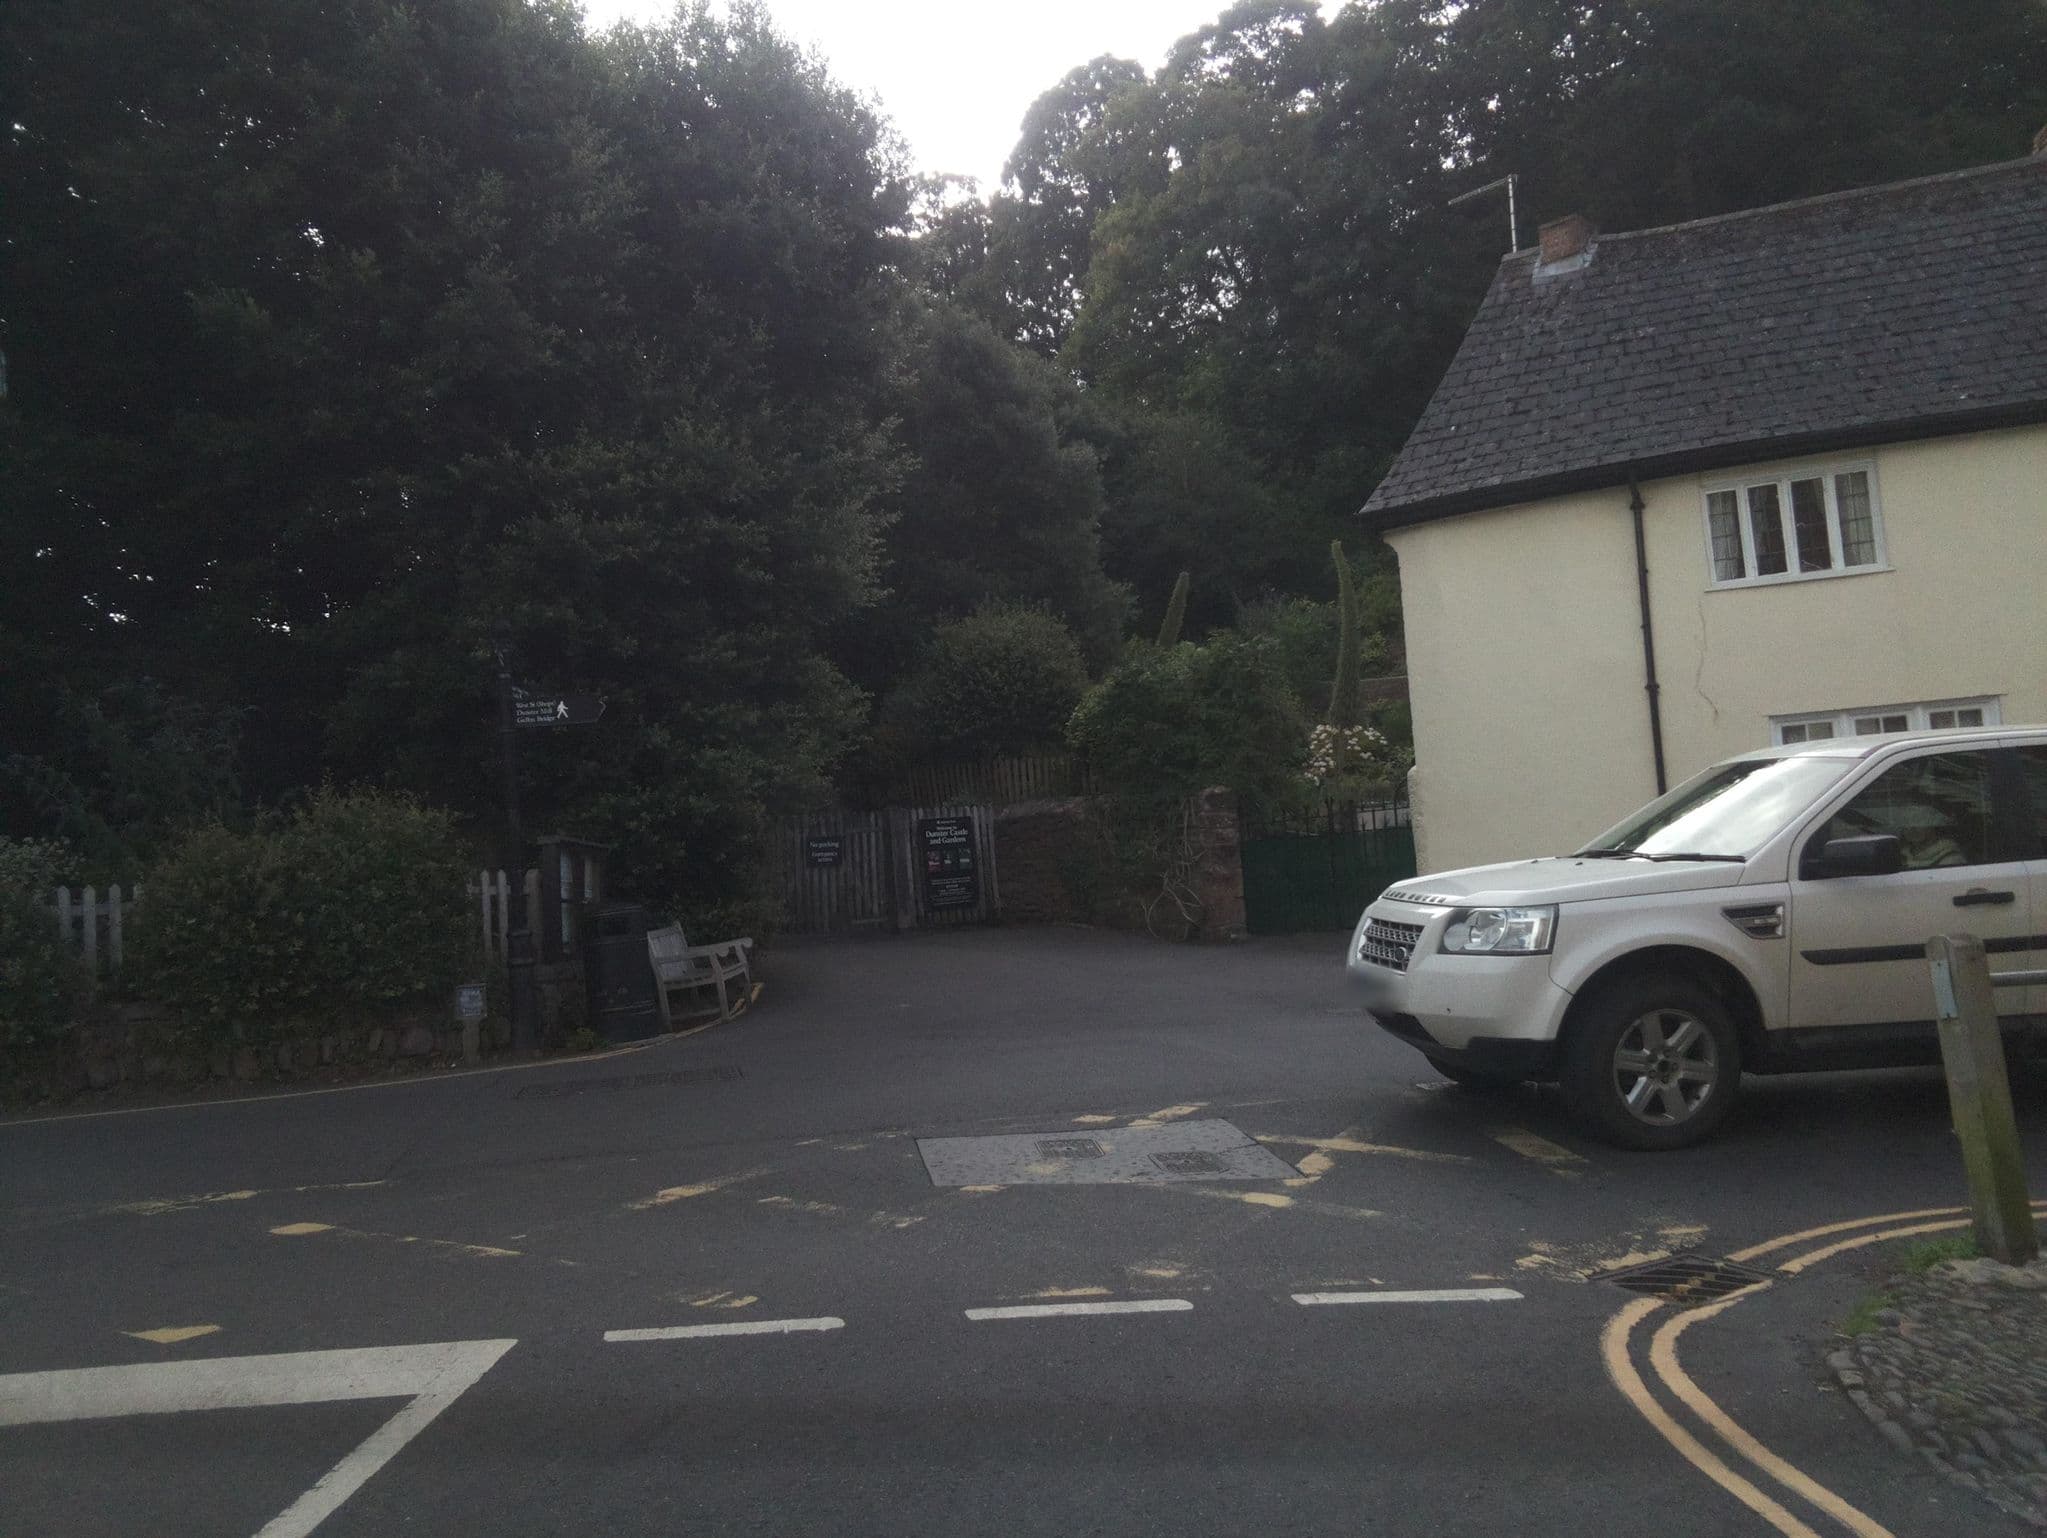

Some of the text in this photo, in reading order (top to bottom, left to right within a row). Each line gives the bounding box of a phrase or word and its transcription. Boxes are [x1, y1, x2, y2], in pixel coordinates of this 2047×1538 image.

[925, 828, 969, 838] Dunster Castle
[929, 835, 967, 845] and Gardens
[1408, 893, 1447, 903] ROVER
